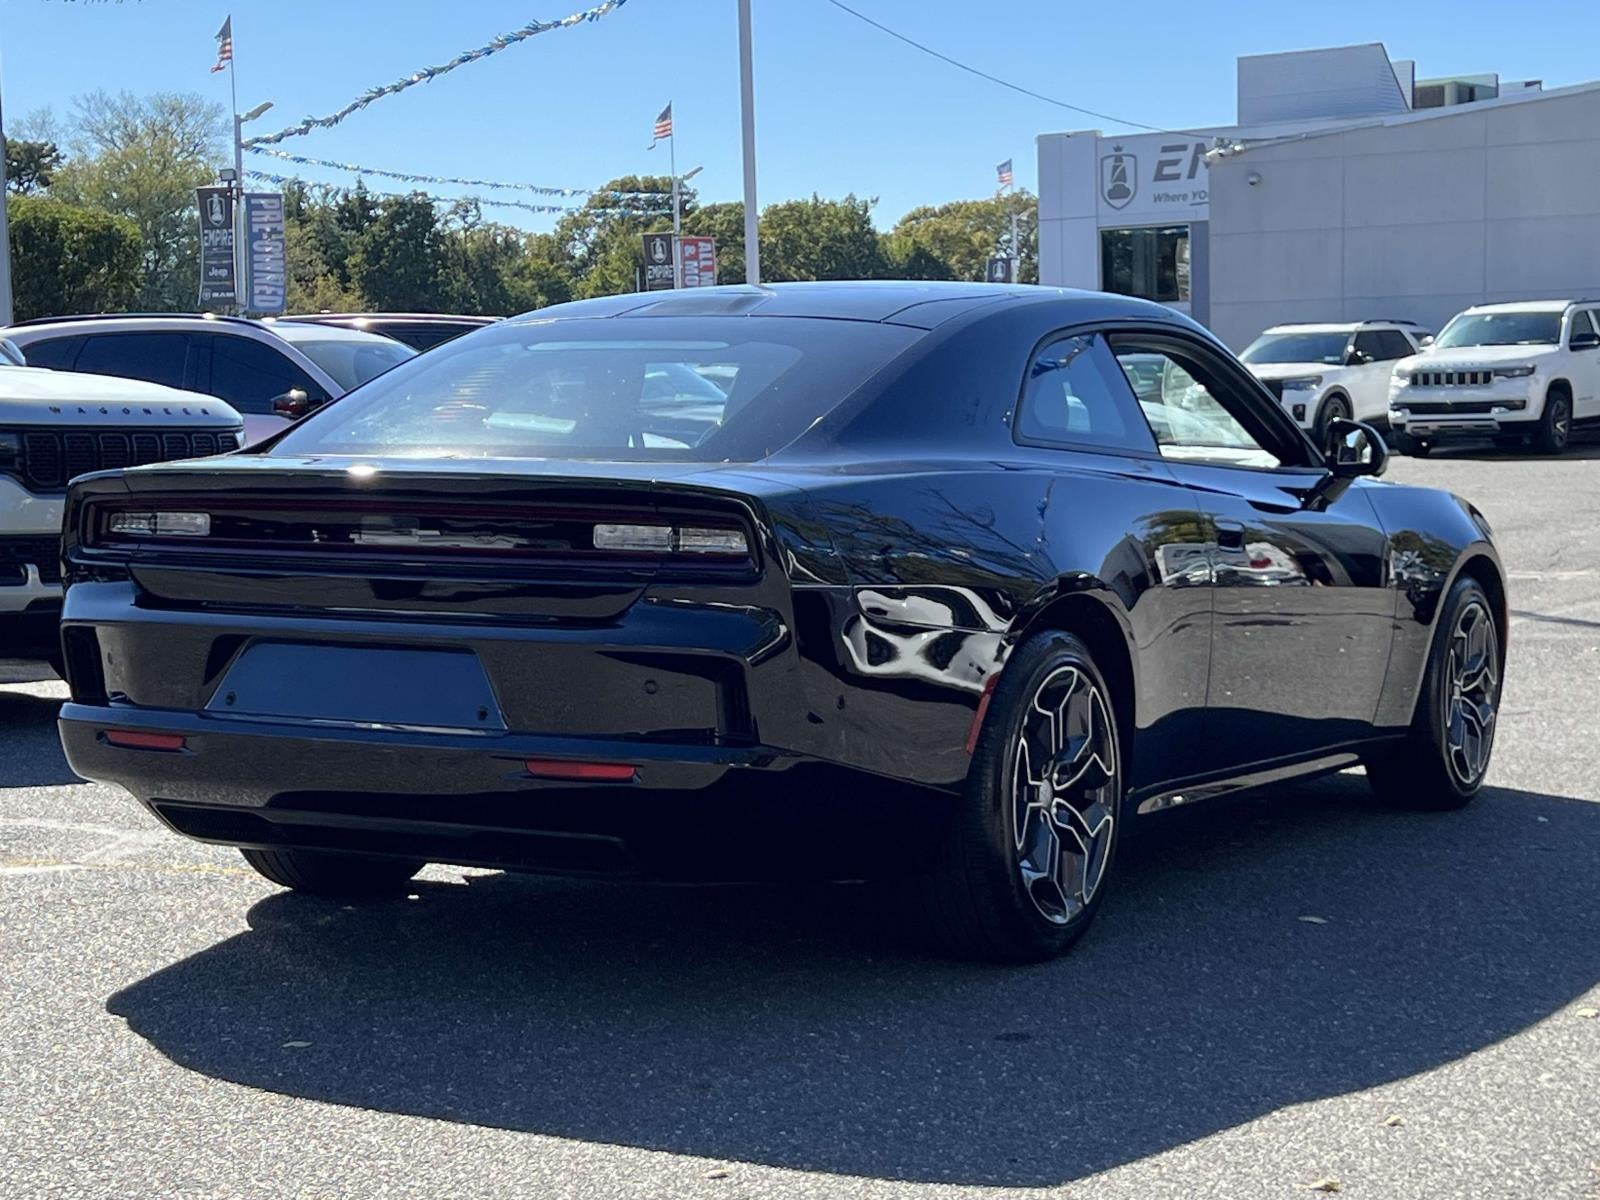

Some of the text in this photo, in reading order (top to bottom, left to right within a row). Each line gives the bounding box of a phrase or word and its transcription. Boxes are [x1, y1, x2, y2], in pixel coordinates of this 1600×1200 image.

[1153, 192, 1188, 203] Where
[250, 198, 285, 307] PRE-OWNED
[208, 267, 228, 278] Jeep
[49, 406, 209, 415] WAGONEER
